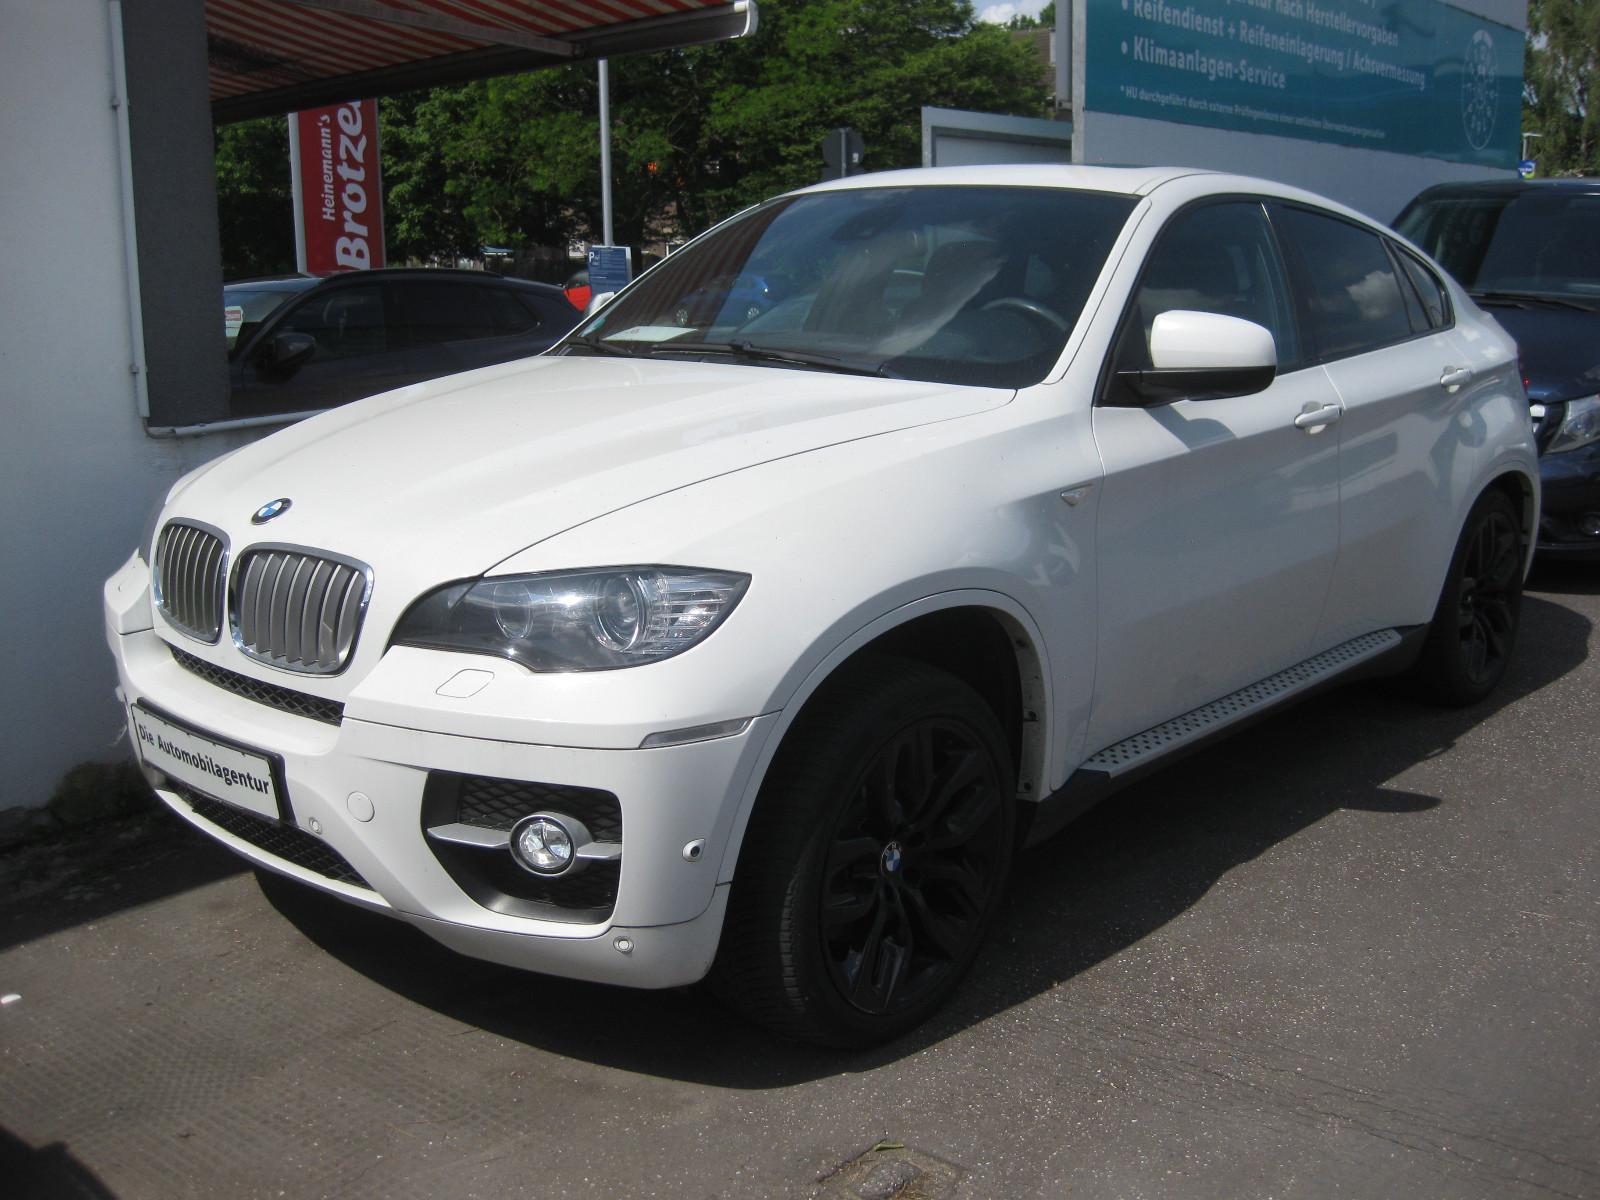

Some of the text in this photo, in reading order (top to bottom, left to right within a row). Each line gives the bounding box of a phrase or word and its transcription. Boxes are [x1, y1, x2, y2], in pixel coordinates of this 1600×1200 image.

[1133, 0, 1224, 37] Reifendienst
[1240, 20, 1344, 71] Reifeneinlagerung
[1353, 51, 1425, 91] Achsvermessung
[1306, 1, 1398, 47] Herstellervorgaben
[1133, 36, 1287, 89] Klimaanlagen-Service
[335, 101, 371, 270] Brotze
[139, 724, 269, 794] Die Automobilagentur
